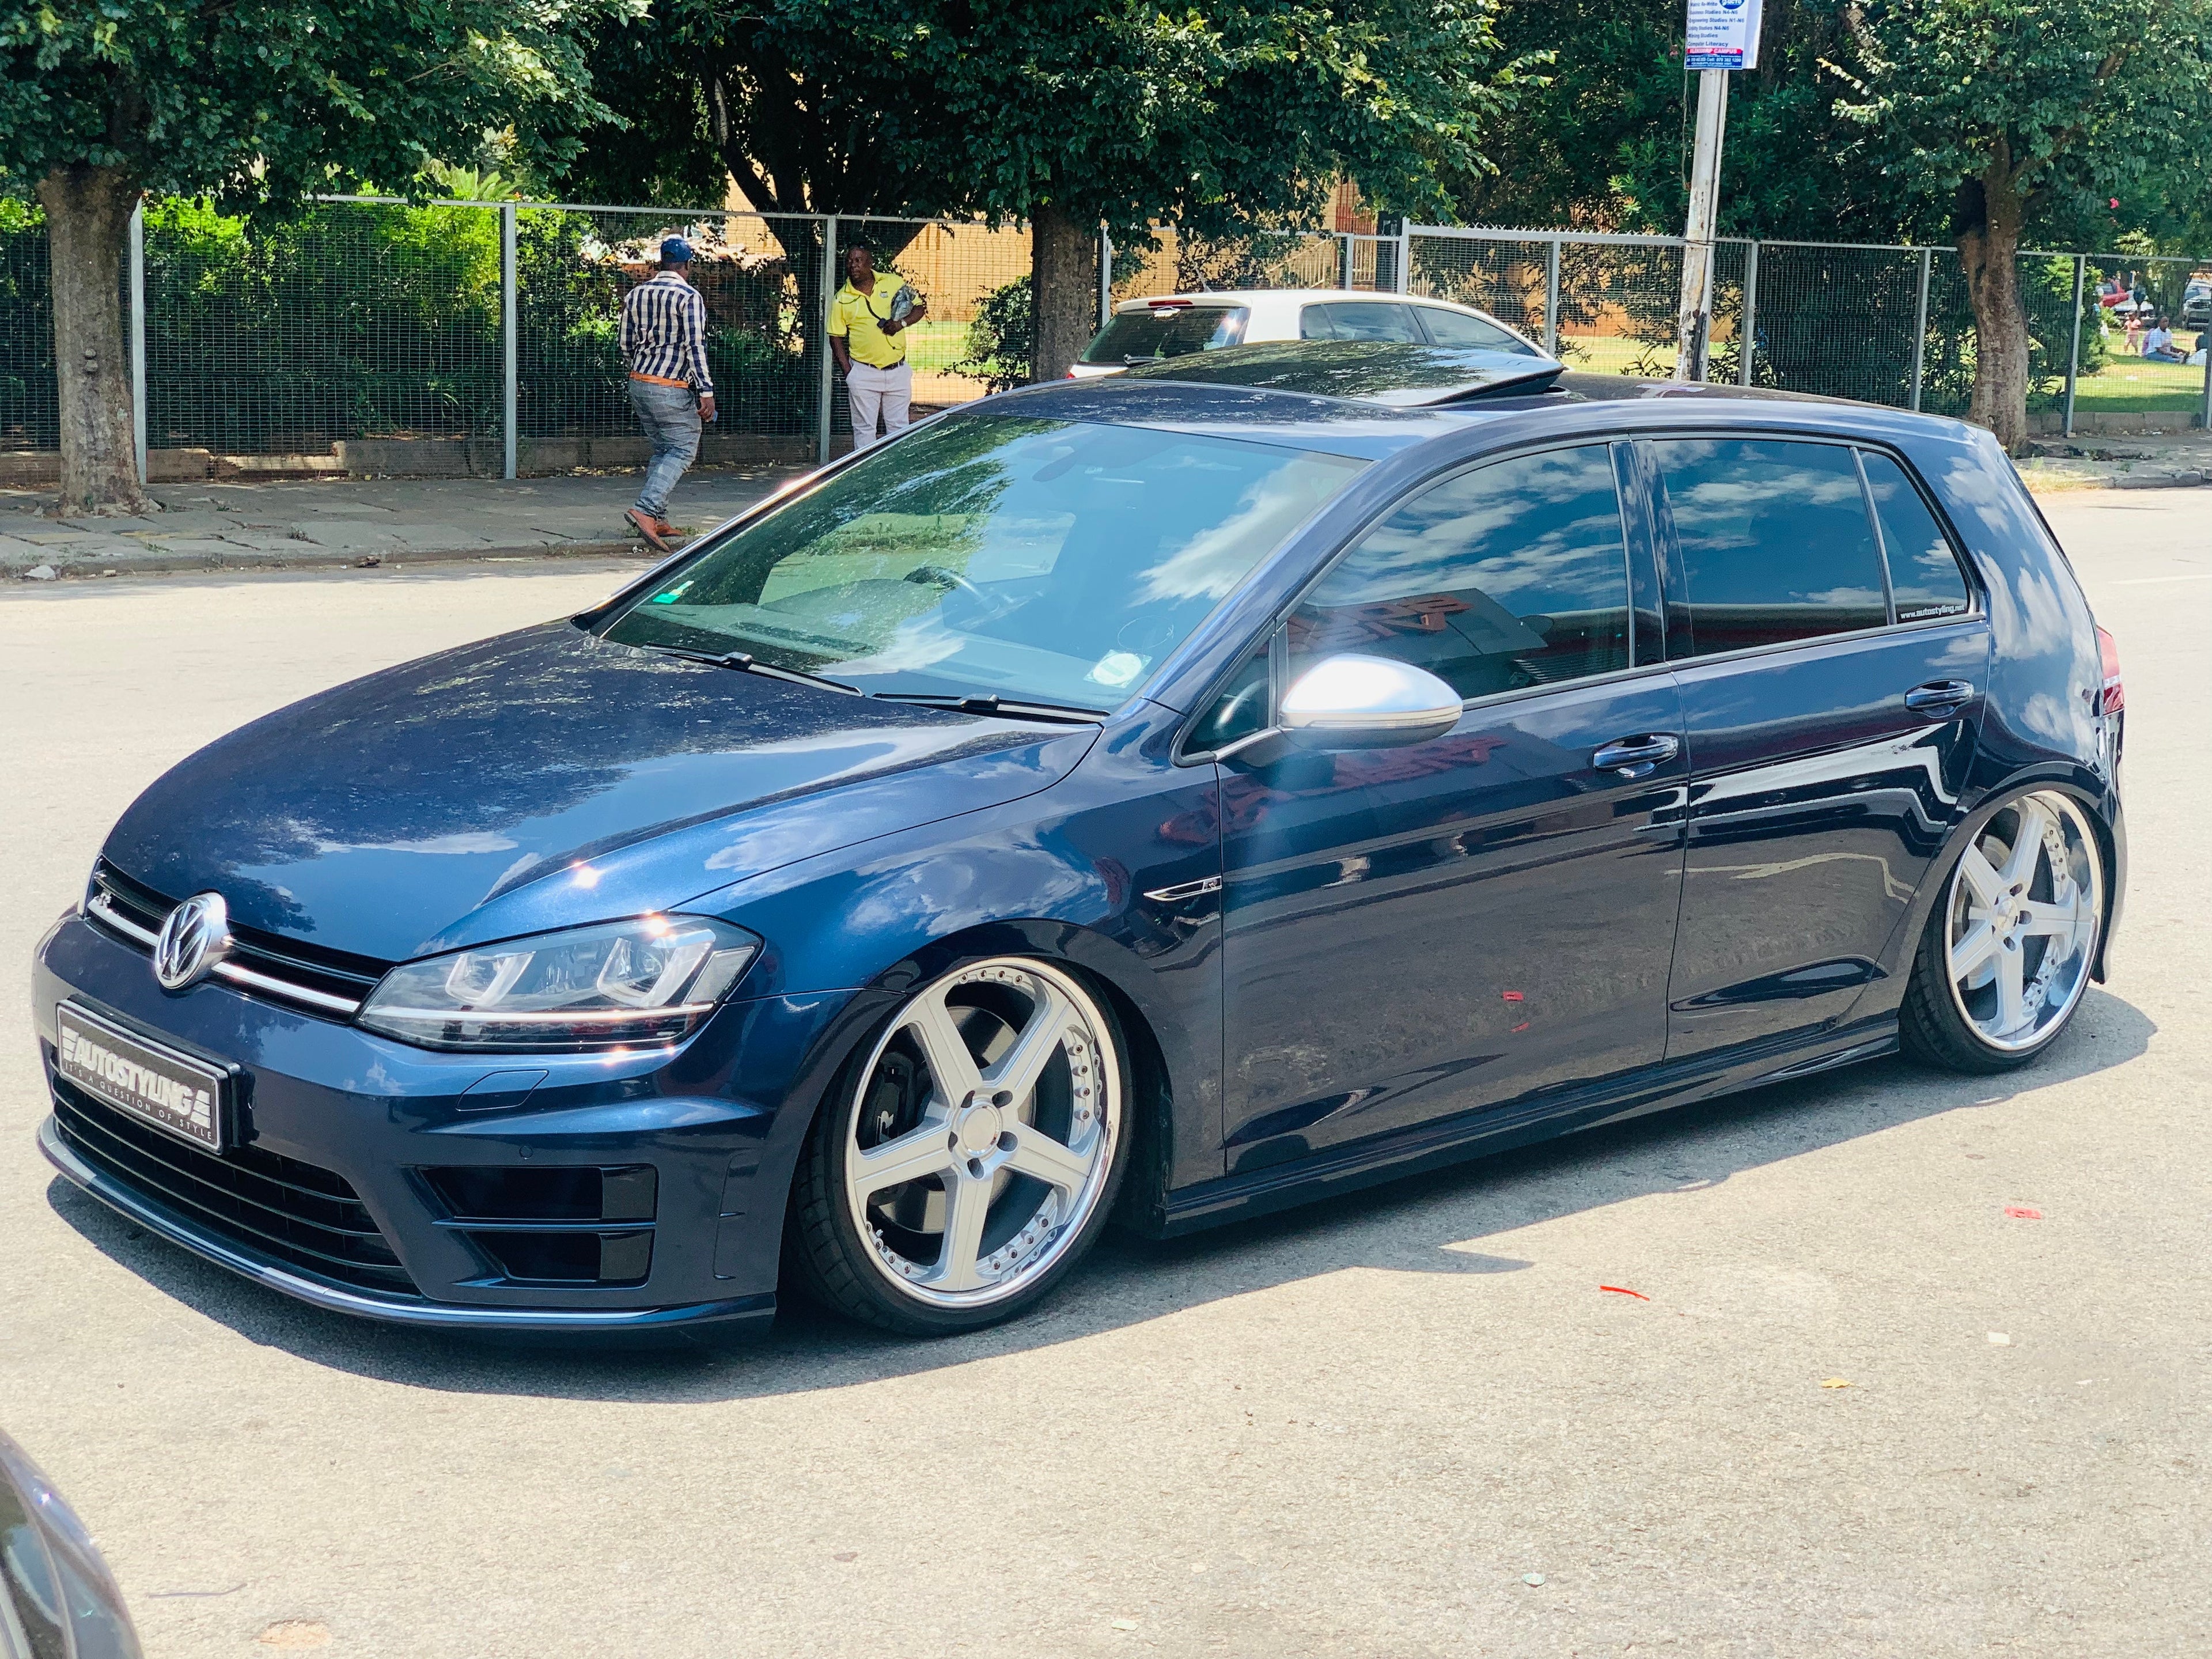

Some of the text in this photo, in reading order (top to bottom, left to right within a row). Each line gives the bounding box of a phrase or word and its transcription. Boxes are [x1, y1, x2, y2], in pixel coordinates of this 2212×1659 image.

[1900, 605, 1964, 619] www.autostyling.net
[65, 1063, 213, 1141] IT'S A QUESTION OF STYLE
[74, 1036, 194, 1116] AUTOSTYLING
